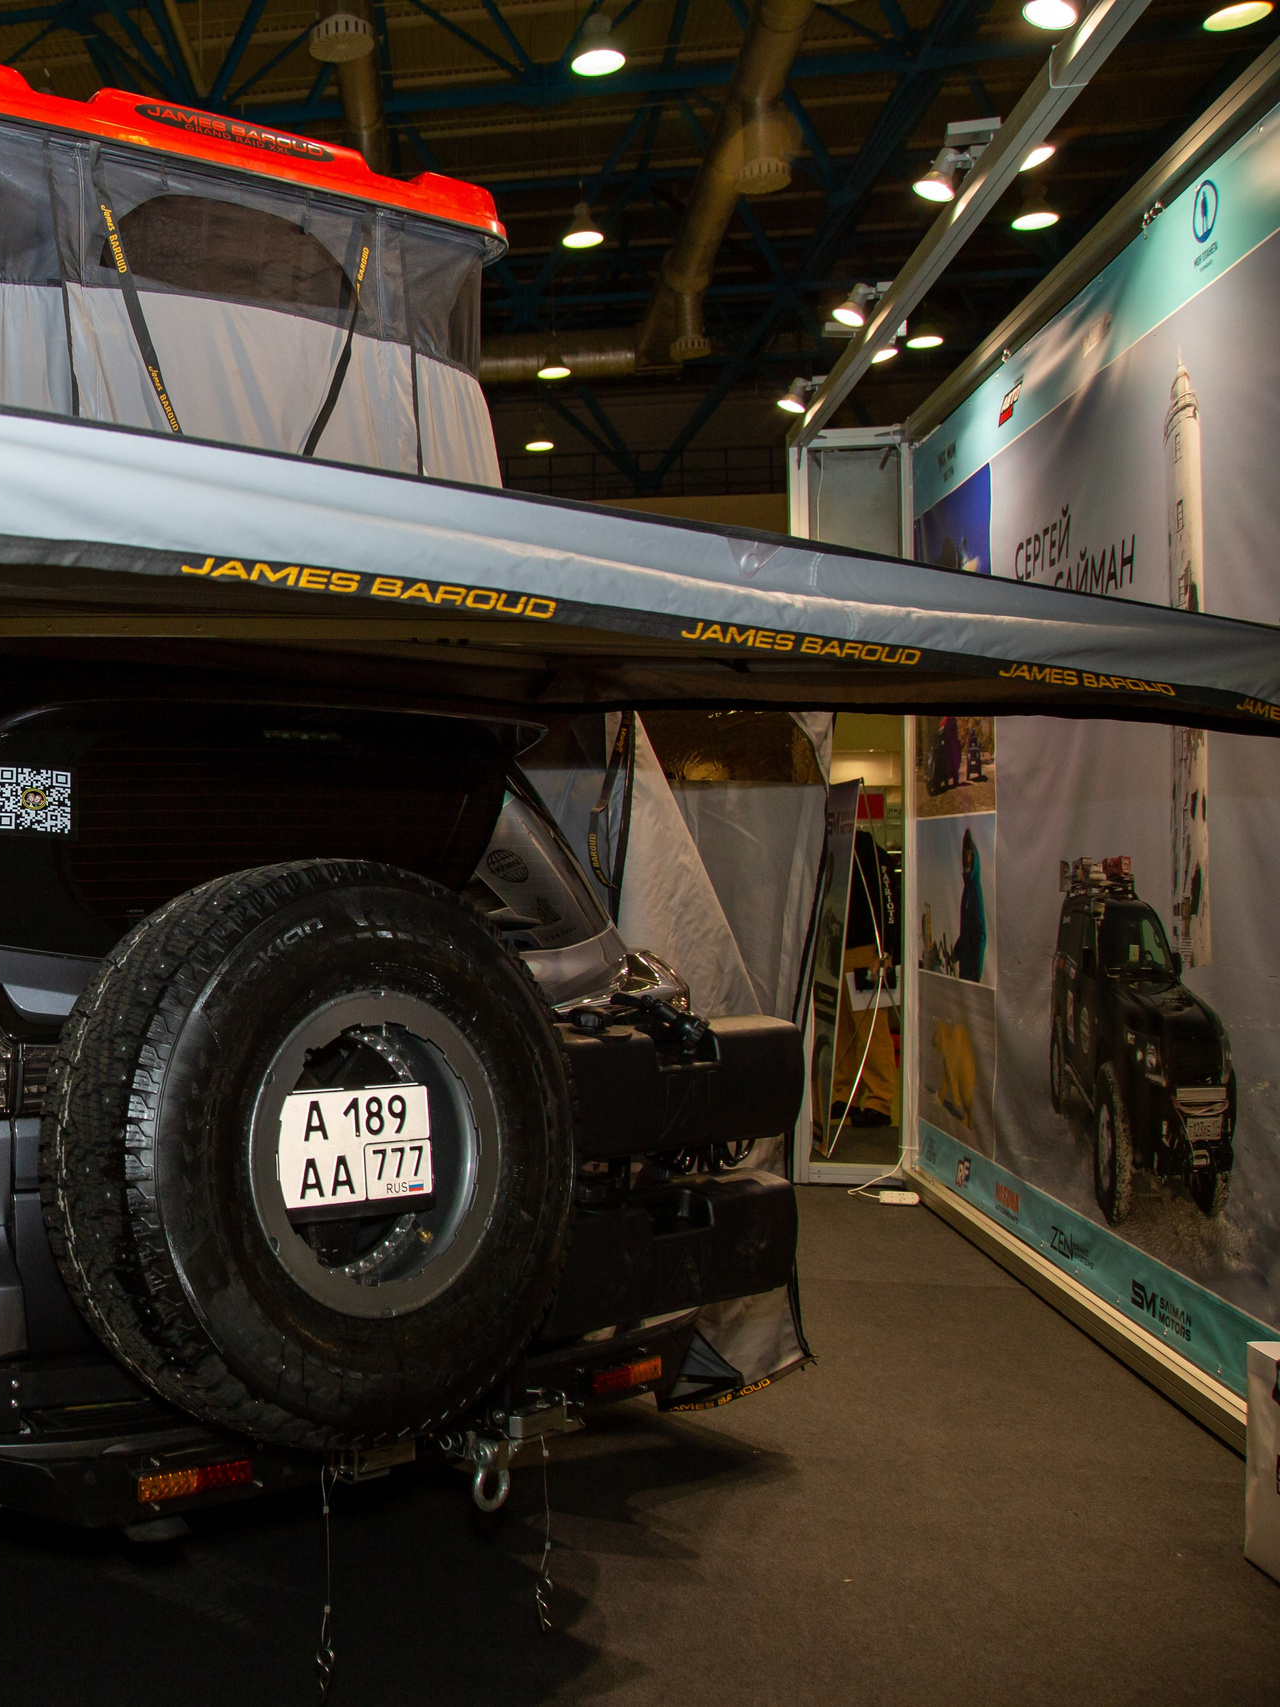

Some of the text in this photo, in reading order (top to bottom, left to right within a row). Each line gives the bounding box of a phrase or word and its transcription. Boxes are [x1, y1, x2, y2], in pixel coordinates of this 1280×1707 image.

[147, 107, 324, 156] JAMES BAROUD
[185, 123, 291, 155] GRAND RAID XXL
[101, 204, 128, 273] James BAROUD
[357, 247, 370, 282] BAROUD
[160, 393, 179, 431] BAROUD
[1015, 504, 1071, 581] СЕРГЕЙ
[181, 557, 557, 619] JAMES BAROUD
[682, 622, 922, 665] JAMES BAROUD
[999, 663, 1176, 697] JAMES BAROUD
[1236, 698, 1280, 721] JAME
[589, 833, 600, 867] BAROUD
[881, 865, 895, 924] PATRIOTS
[343, 1094, 407, 1138] 189
[372, 1145, 424, 1181] 777
[386, 1182, 408, 1194] RUS
[1158, 1310, 1192, 1342] MOTORS
[1159, 1297, 1192, 1327] SAIMAN
[669, 1402, 714, 1411] AMES
